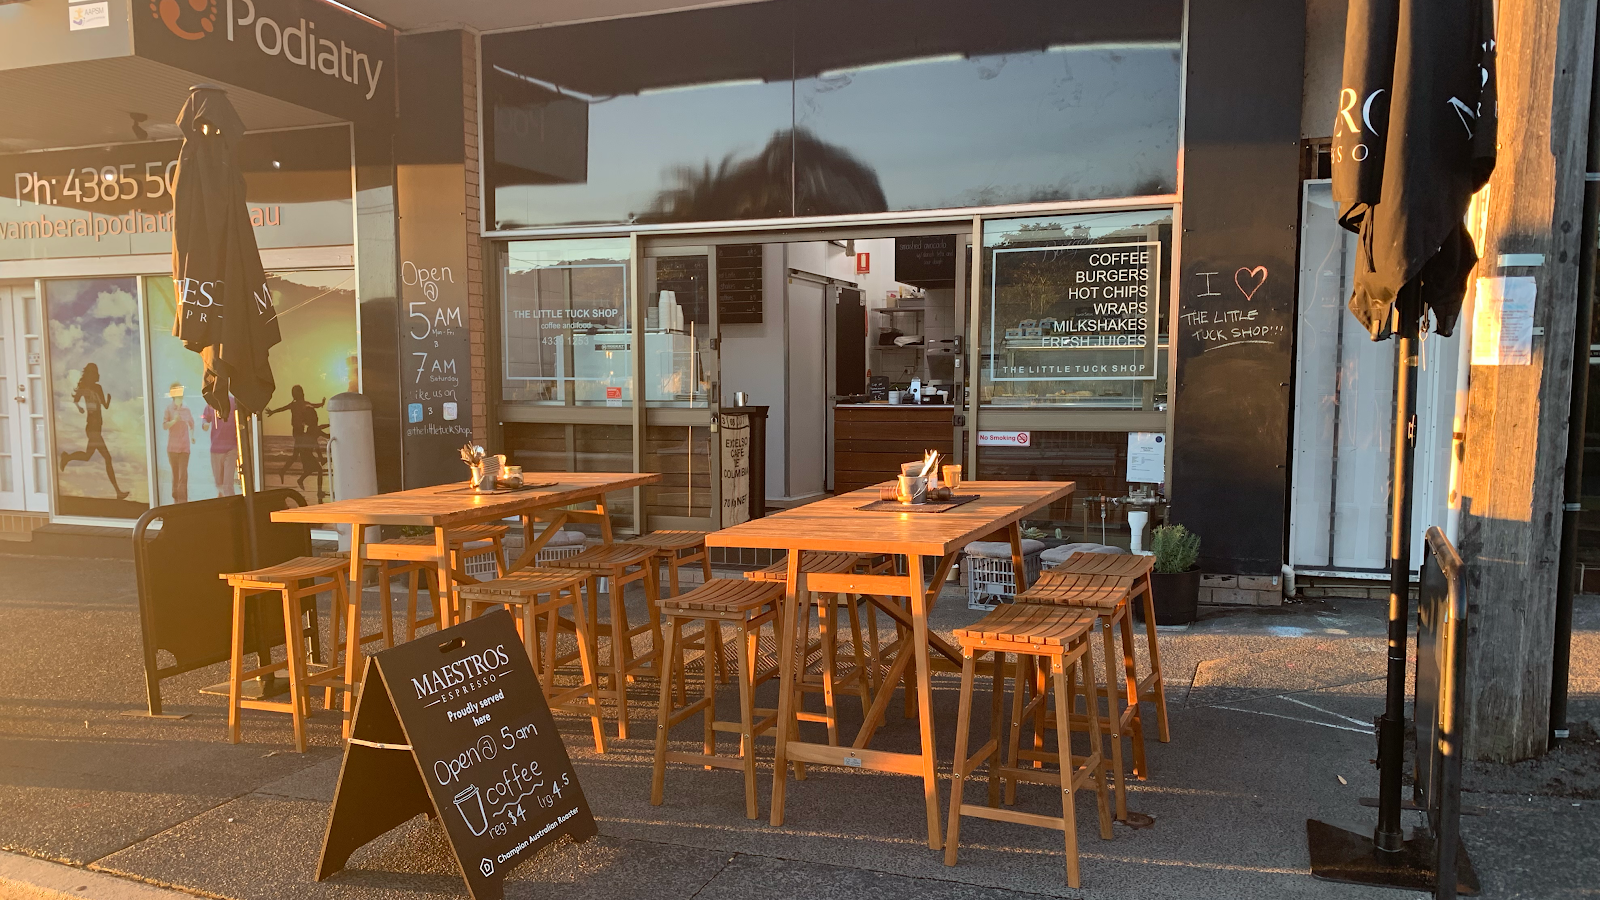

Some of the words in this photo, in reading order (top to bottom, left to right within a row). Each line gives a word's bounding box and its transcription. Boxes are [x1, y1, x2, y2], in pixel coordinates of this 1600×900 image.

[226, 0, 384, 100] Podiatry
[15, 172, 57, 207] Ph:
[63, 163, 138, 203] 4385
[145, 160, 178, 198] 50
[251, 205, 281, 227] au
[1089, 251, 1150, 267] COFFEE
[402, 260, 454, 288] Open
[1075, 268, 1149, 284] BURGERS
[424, 281, 438, 302] @
[1068, 286, 1100, 300] HOT
[1102, 285, 1149, 299] CHIPS
[1195, 271, 1222, 298] I
[513, 309, 531, 319] THE
[532, 308, 563, 318] LITTLE
[565, 308, 590, 318] TUCK
[592, 307, 618, 318] SHOP
[1093, 301, 1148, 316] WRAPS
[409, 302, 431, 340] 5
[434, 306, 462, 327] AM
[541, 321, 561, 330] coffee
[562, 322, 573, 330] and
[574, 321, 592, 330] food
[1053, 318, 1148, 333] MILKSHAKES
[1180, 310, 1209, 326] THE
[1213, 309, 1259, 324] LITTLE
[567, 335, 590, 346] 1253
[1042, 337, 1090, 349] FRESH
[1093, 334, 1147, 348] JUICES
[1191, 328, 1228, 341] TUCK
[412, 352, 427, 384] 7
[431, 358, 456, 374] AM
[1003, 366, 1025, 374] THE
[1028, 366, 1071, 374] LITTLE
[1075, 365, 1107, 373] TUCK
[1111, 364, 1146, 373] SHOP
[429, 374, 459, 388] Saturday
[433, 390, 443, 398] us
[444, 389, 458, 402] on
[410, 644, 509, 700] MAESTROS
[441, 674, 496, 703] ESPRESSO
[446, 701, 479, 722] Proudly
[479, 688, 505, 709] served
[472, 713, 491, 727] here
[486, 761, 543, 805] coffee
[497, 840, 530, 864] Champion
[528, 821, 559, 845] Australian
[557, 806, 579, 825] Roaster
